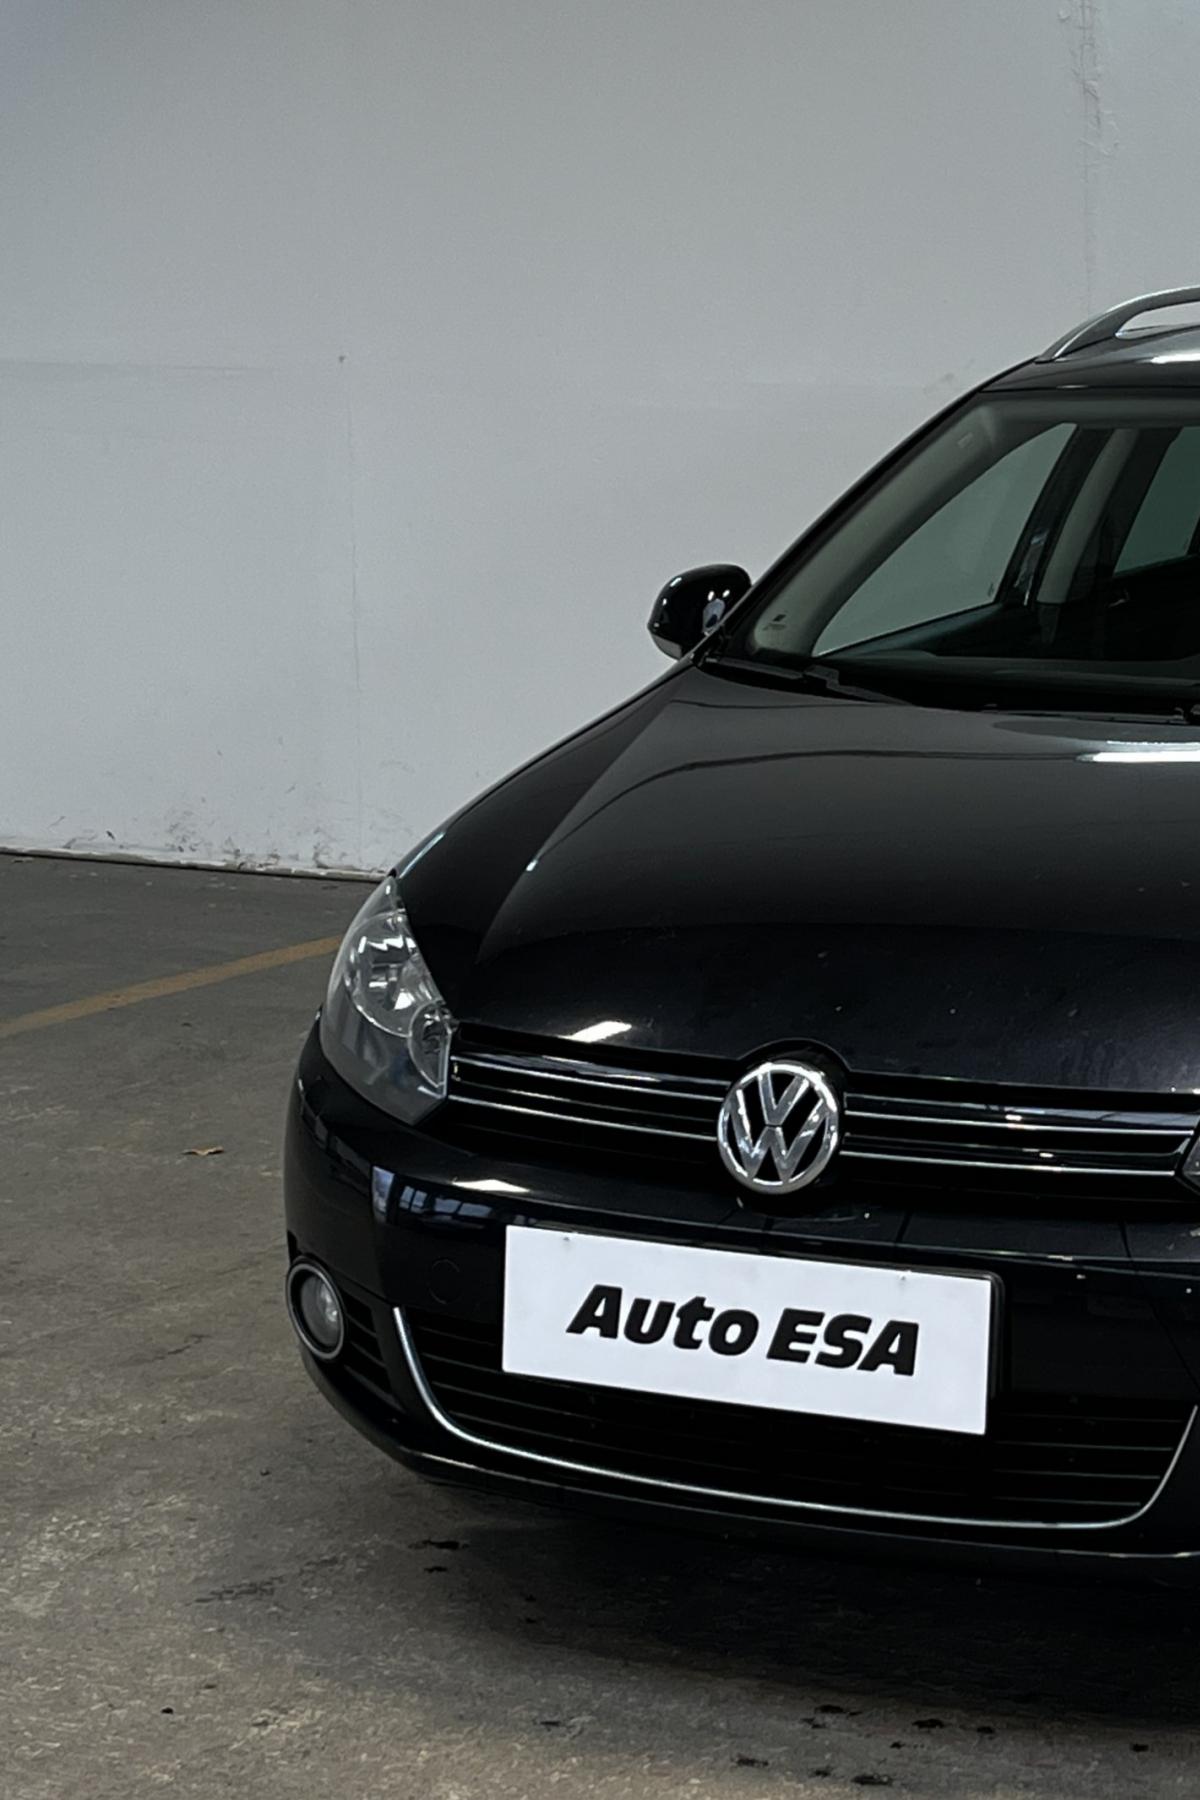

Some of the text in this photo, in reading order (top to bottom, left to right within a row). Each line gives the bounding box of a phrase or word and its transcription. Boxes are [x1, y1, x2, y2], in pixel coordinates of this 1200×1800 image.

[722, 1063, 834, 1190] VW
[565, 1284, 920, 1377] Auto ESA
